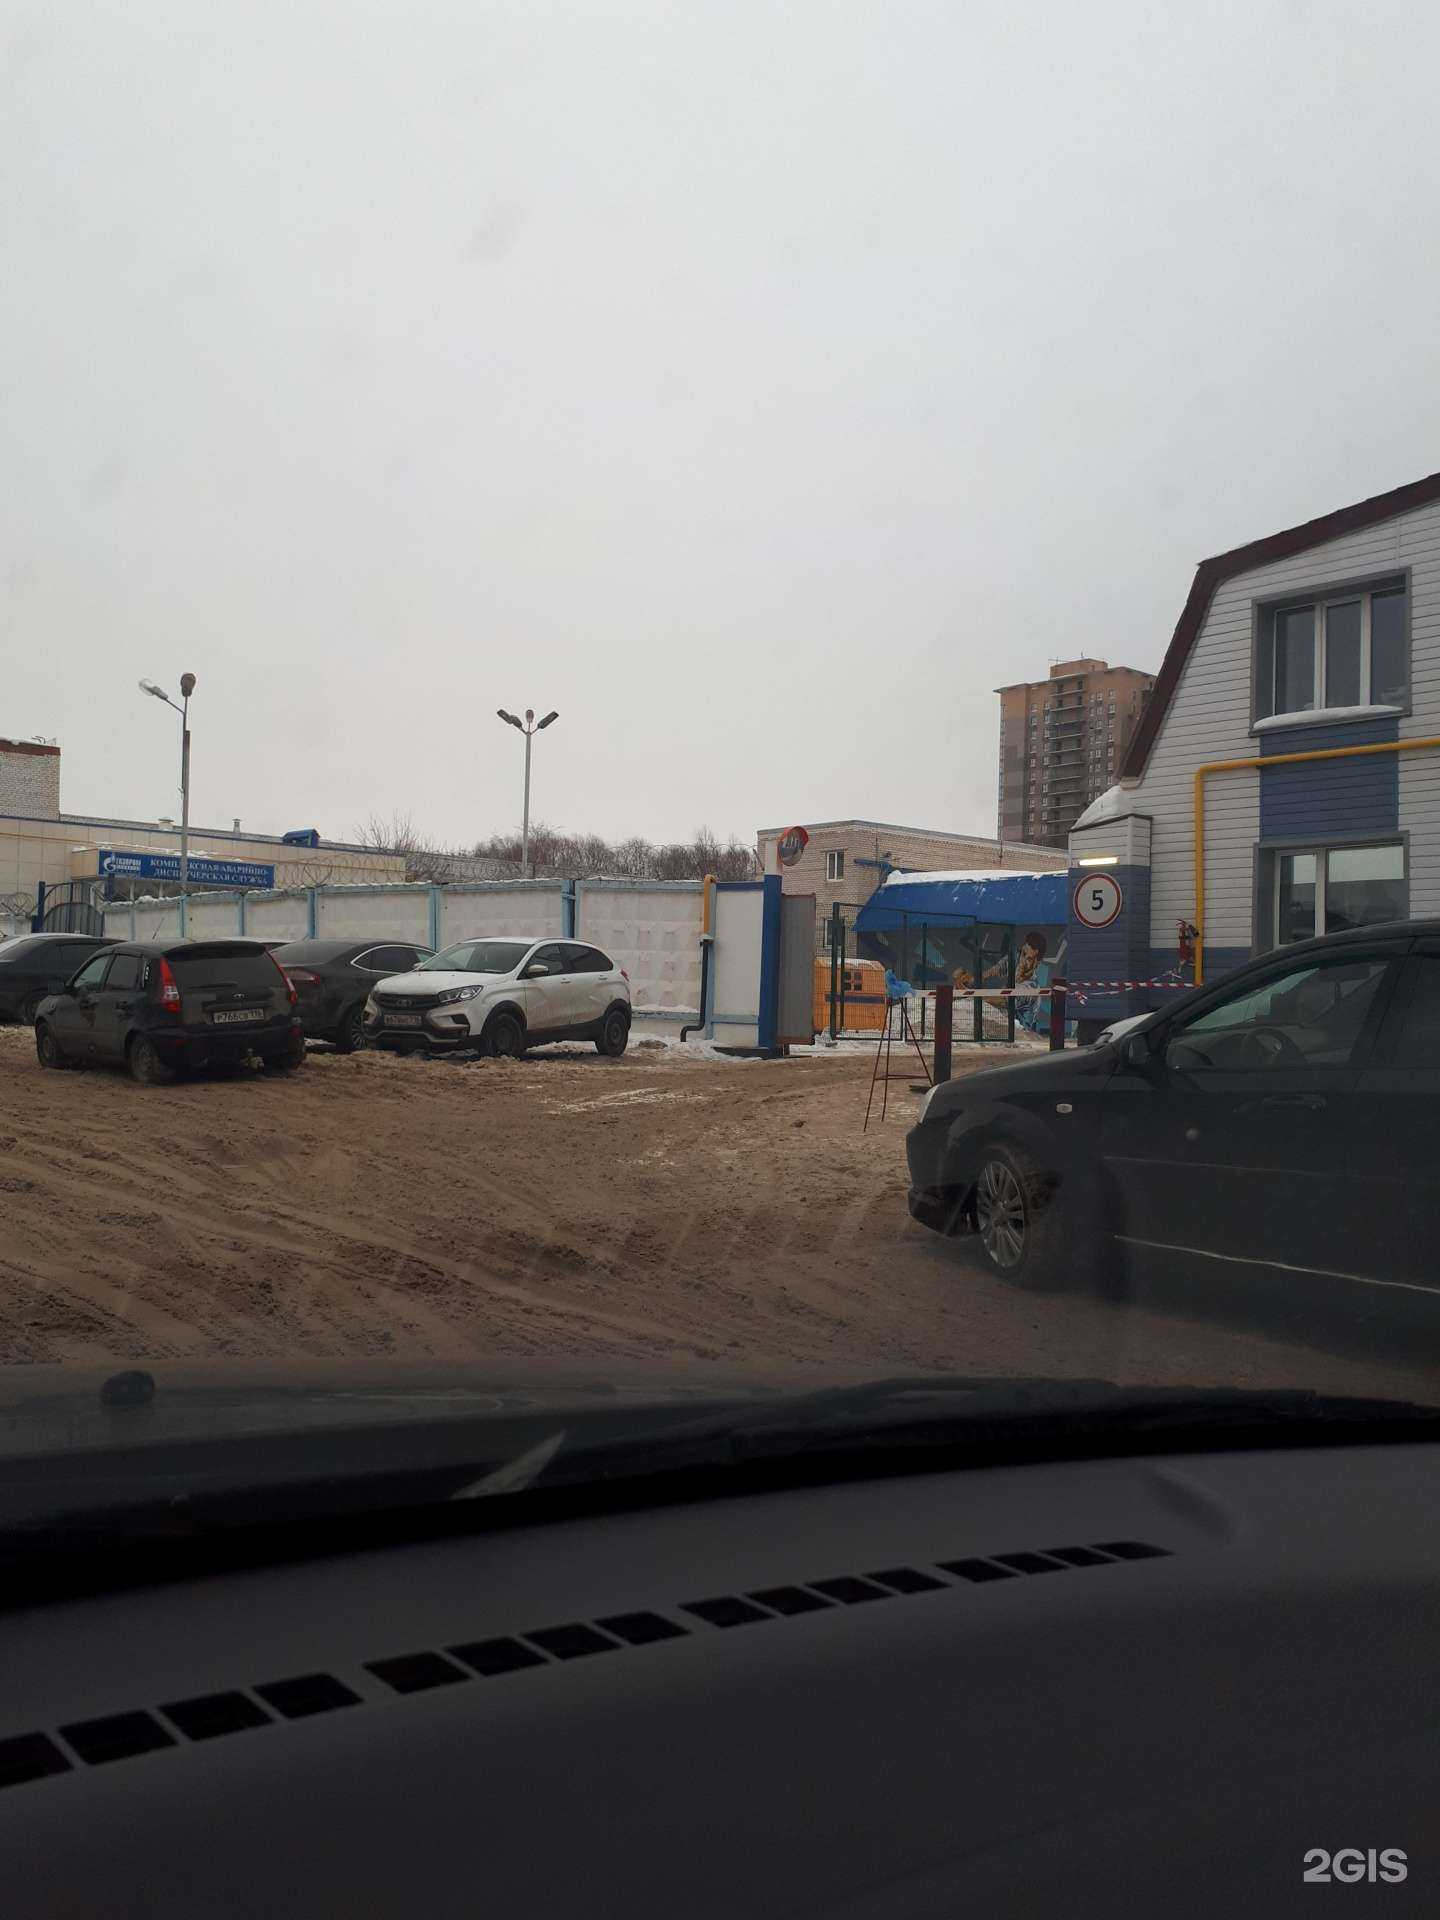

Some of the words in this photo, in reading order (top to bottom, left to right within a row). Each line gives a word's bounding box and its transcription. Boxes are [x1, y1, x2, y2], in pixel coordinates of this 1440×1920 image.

[150, 858, 219, 871] КОМПКСНАЯ
[153, 867, 230, 881] ДИСПЧЕРСКАЯ
[1091, 889, 1104, 911] 5
